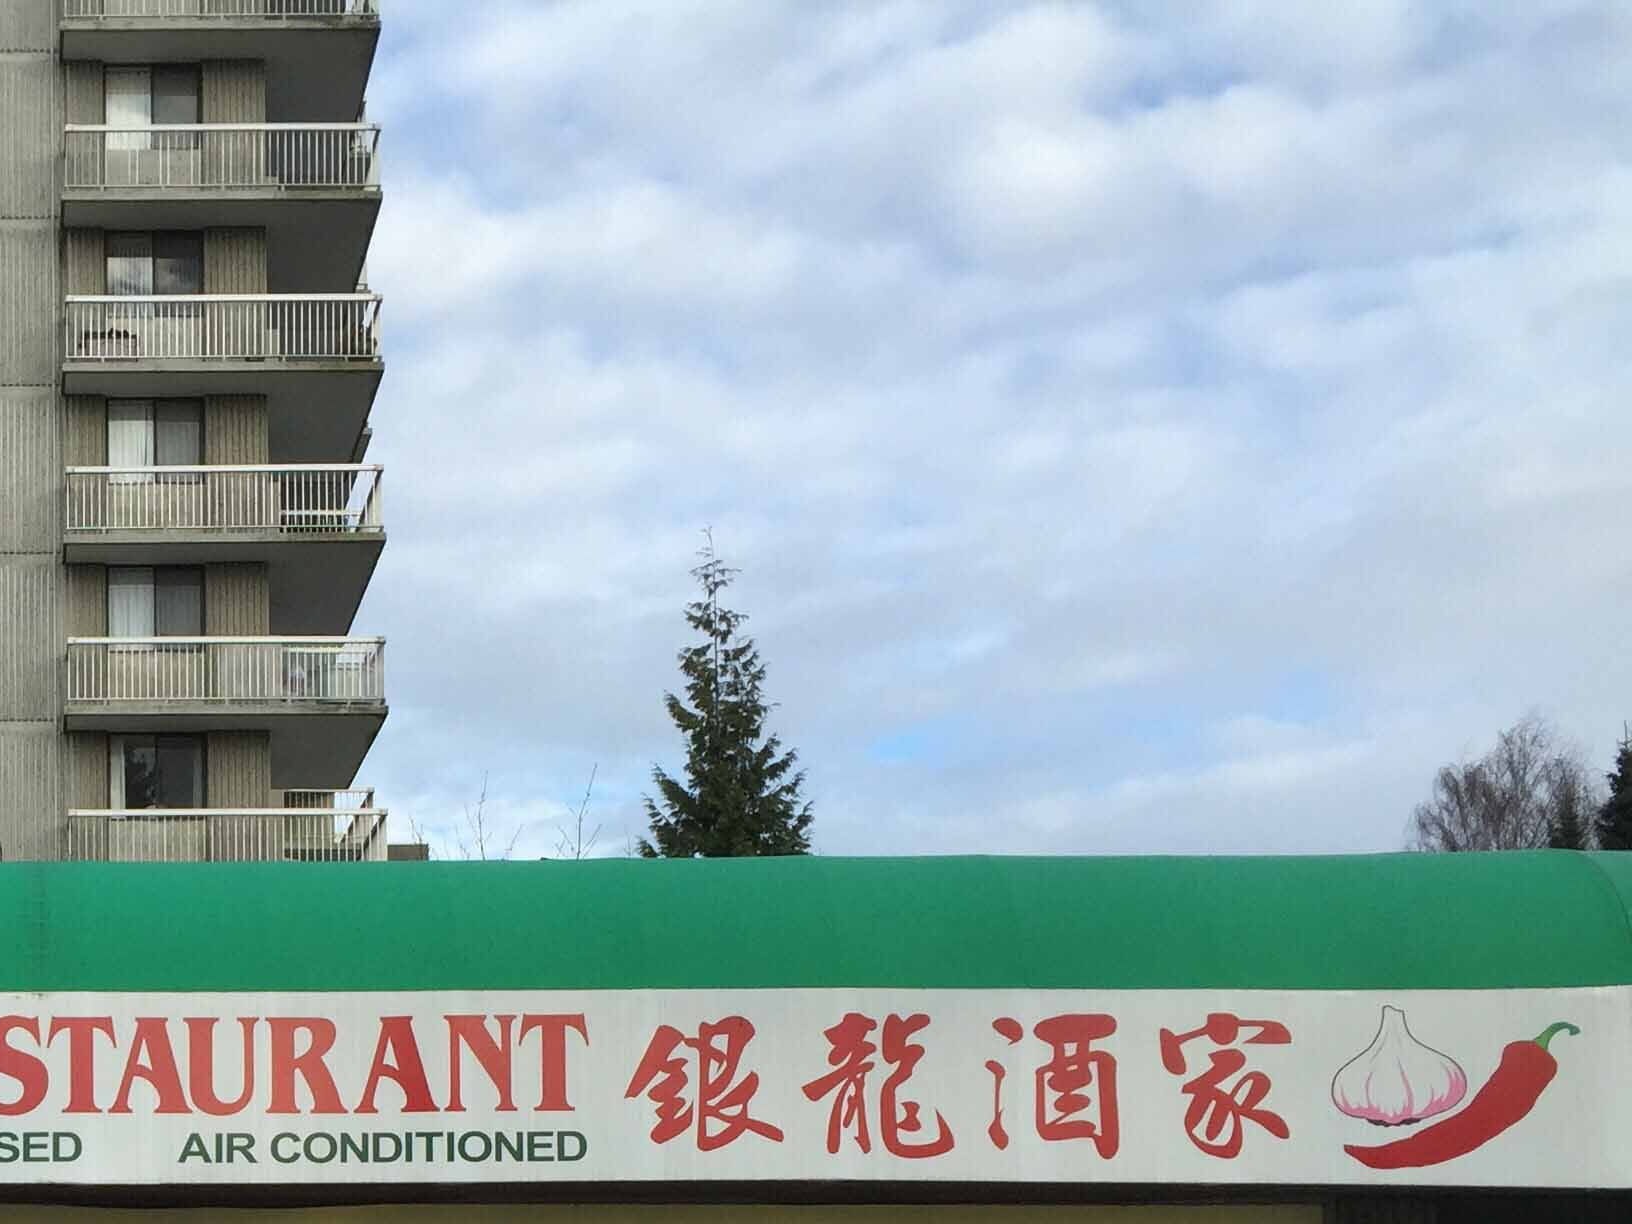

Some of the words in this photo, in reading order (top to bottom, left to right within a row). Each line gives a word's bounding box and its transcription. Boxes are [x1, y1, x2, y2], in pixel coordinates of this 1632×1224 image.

[626, 1013, 1291, 1159] 銀龍酒家
[178, 1133, 257, 1163] AIR
[270, 1130, 588, 1163] CONDITIONED
